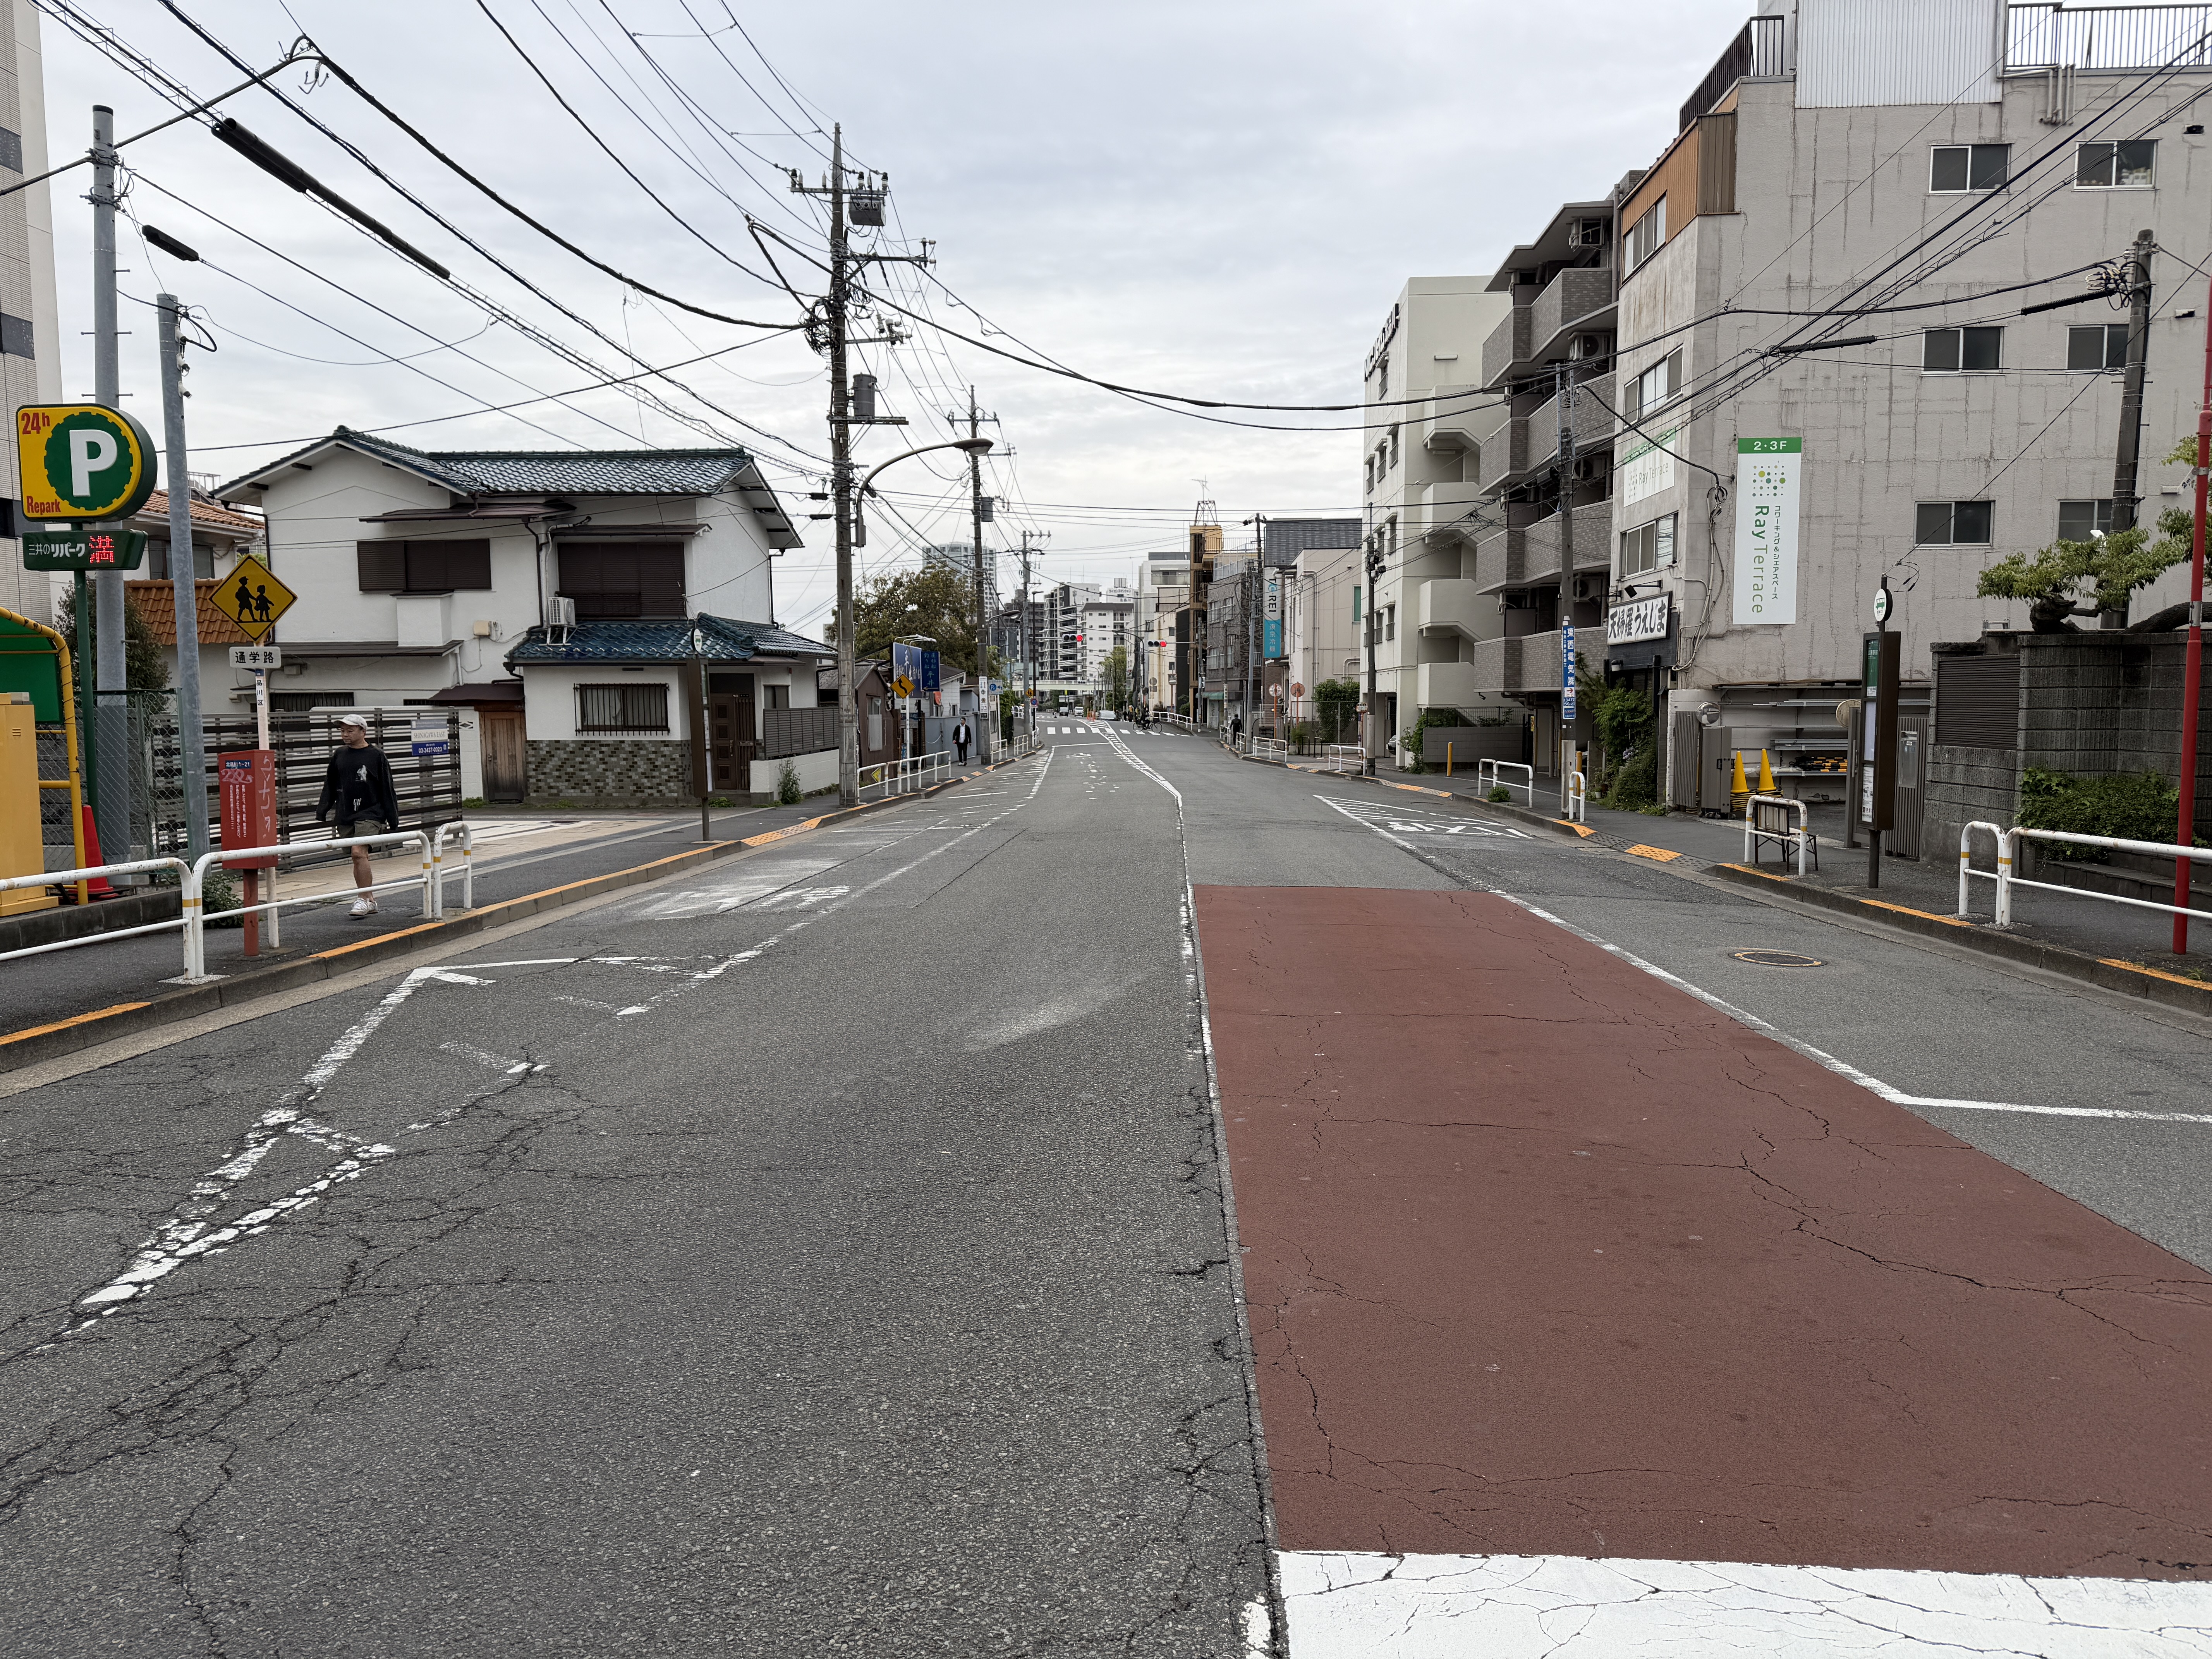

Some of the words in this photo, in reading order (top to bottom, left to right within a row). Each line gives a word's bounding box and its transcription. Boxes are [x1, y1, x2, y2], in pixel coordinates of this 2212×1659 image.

[21, 412, 50, 434] 24h
[69, 429, 117, 497] P
[1638, 471, 1649, 485] Ray
[1649, 462, 1669, 480] Terrace
[26, 496, 61, 515] Repark
[1752, 506, 1769, 539] Ray
[28, 542, 85, 558] 三井のリパーク
[89, 535, 115, 563] 満
[1752, 544, 1768, 613] Terrace
[1608, 599, 1666, 639] 天婦羅うえじま
[235, 651, 274, 663] 通学路
